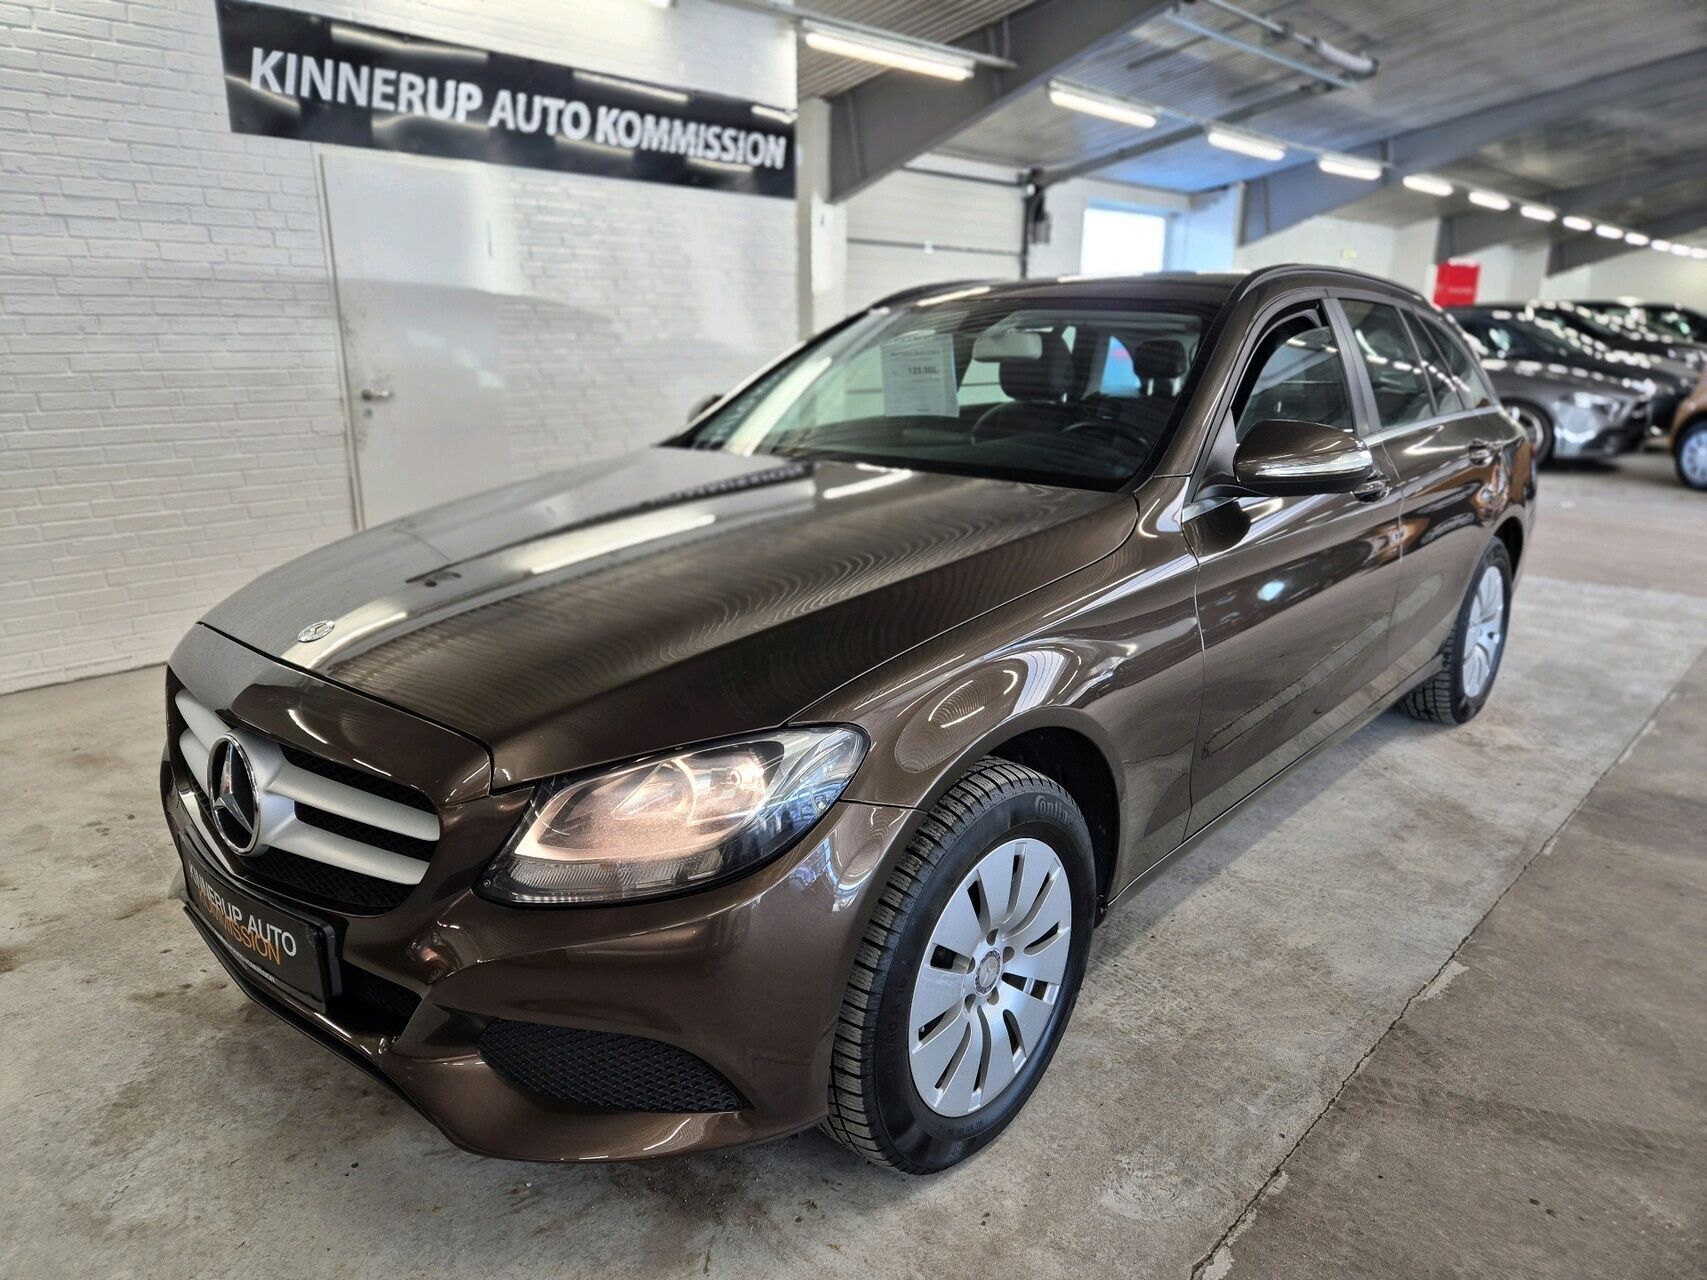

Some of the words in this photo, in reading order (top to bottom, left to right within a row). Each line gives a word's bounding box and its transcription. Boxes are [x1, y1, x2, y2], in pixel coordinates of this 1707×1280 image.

[250, 47, 483, 122] KINNERUP
[488, 89, 591, 141] AUTO
[594, 106, 787, 169] KOMMISSION
[188, 860, 243, 922] KINNERUP
[247, 913, 297, 957] AUTO
